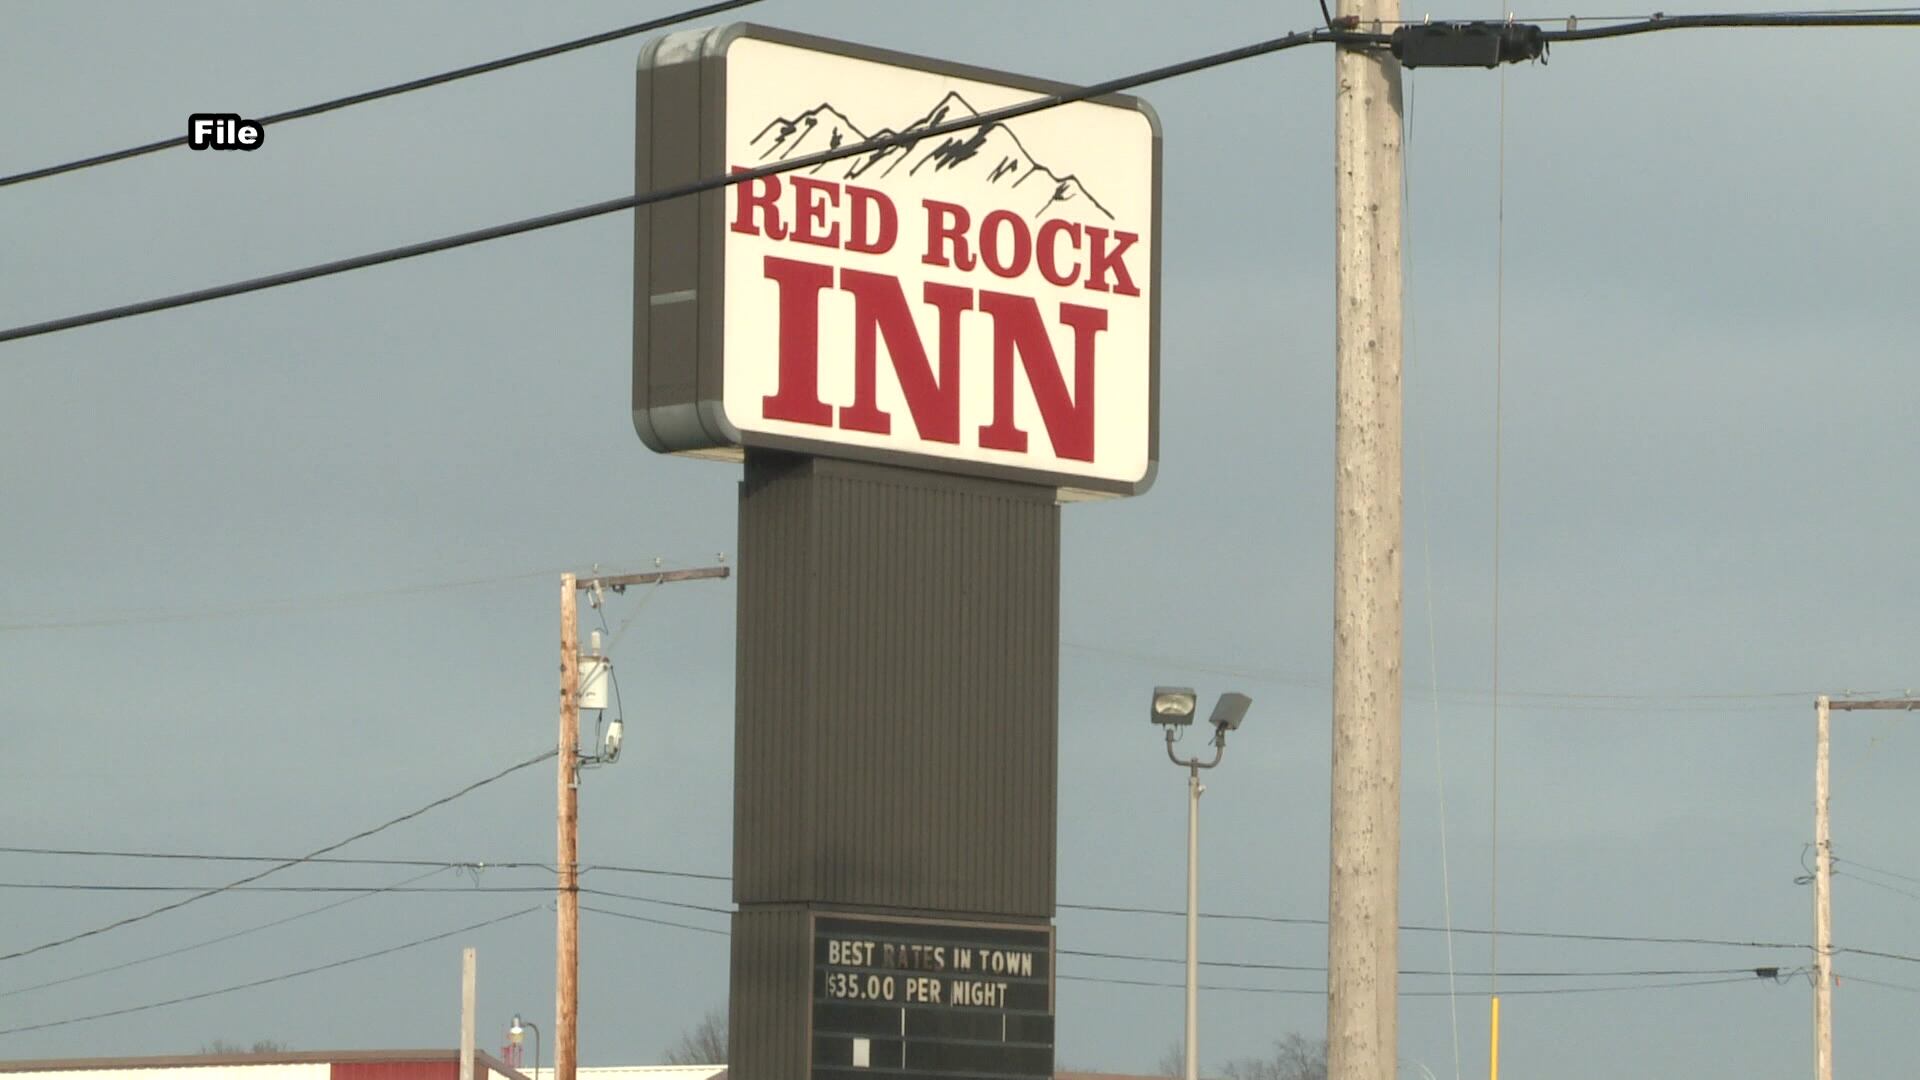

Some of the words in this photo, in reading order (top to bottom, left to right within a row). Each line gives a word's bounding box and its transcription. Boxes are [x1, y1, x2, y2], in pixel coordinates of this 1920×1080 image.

[730, 165, 898, 254] RED
[922, 198, 1140, 296] ROCK
[763, 256, 1108, 464] INN
[828, 939, 875, 967] BEST
[883, 944, 945, 970] RATES
[954, 948, 971, 971] IN
[979, 950, 1033, 977] TOWN
[828, 973, 894, 1001] $35.00
[906, 977, 941, 1004] PER
[952, 980, 1008, 1008] NIGHT
